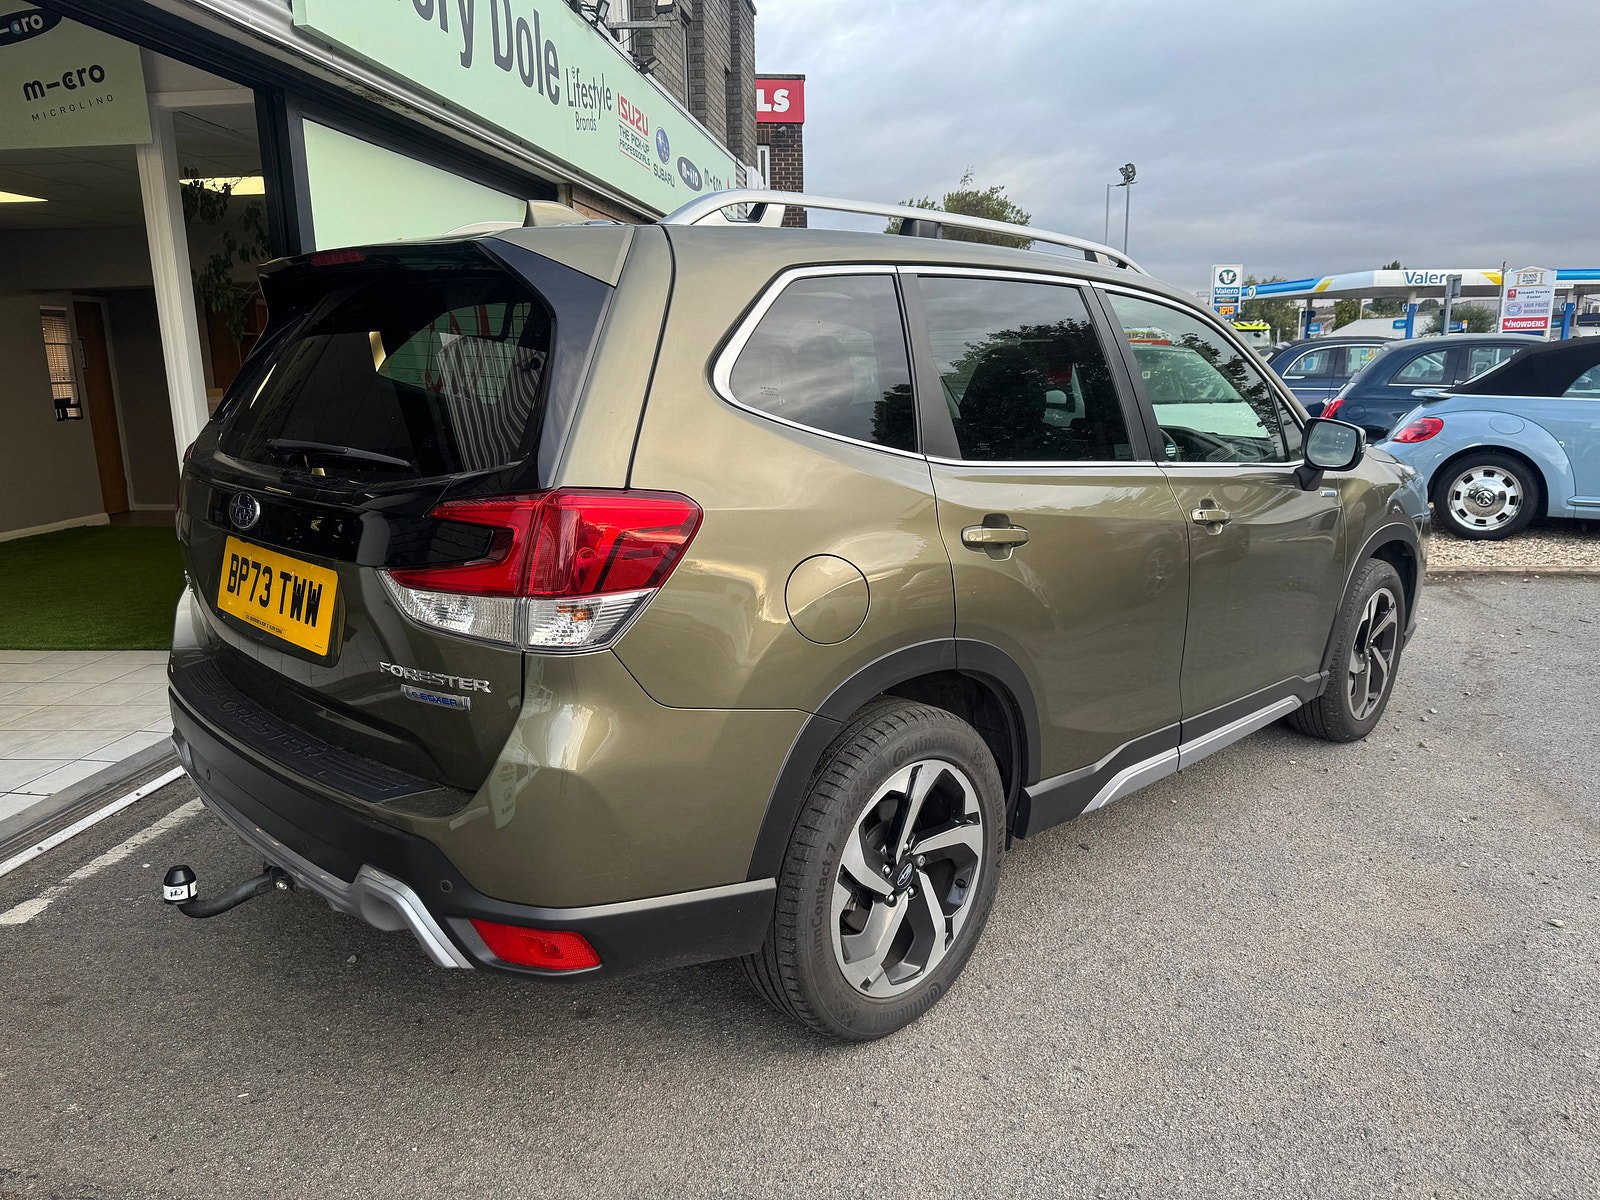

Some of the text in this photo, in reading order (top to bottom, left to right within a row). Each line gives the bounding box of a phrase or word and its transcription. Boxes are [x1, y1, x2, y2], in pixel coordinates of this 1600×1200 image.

[490, 0, 560, 105] Dole
[31, 94, 114, 121] MICROLINO
[565, 66, 612, 120] Lifestyle
[756, 88, 790, 113] LS
[575, 111, 597, 131] Brands
[617, 92, 649, 136] ISUZU
[618, 124, 650, 154] THE PICK-UP
[619, 138, 651, 166] PROFESSIONALS
[653, 163, 675, 188] SUBARU
[1404, 271, 1446, 284] Valer
[226, 553, 323, 628] BP73 TWW
[379, 661, 492, 693] FORESTER
